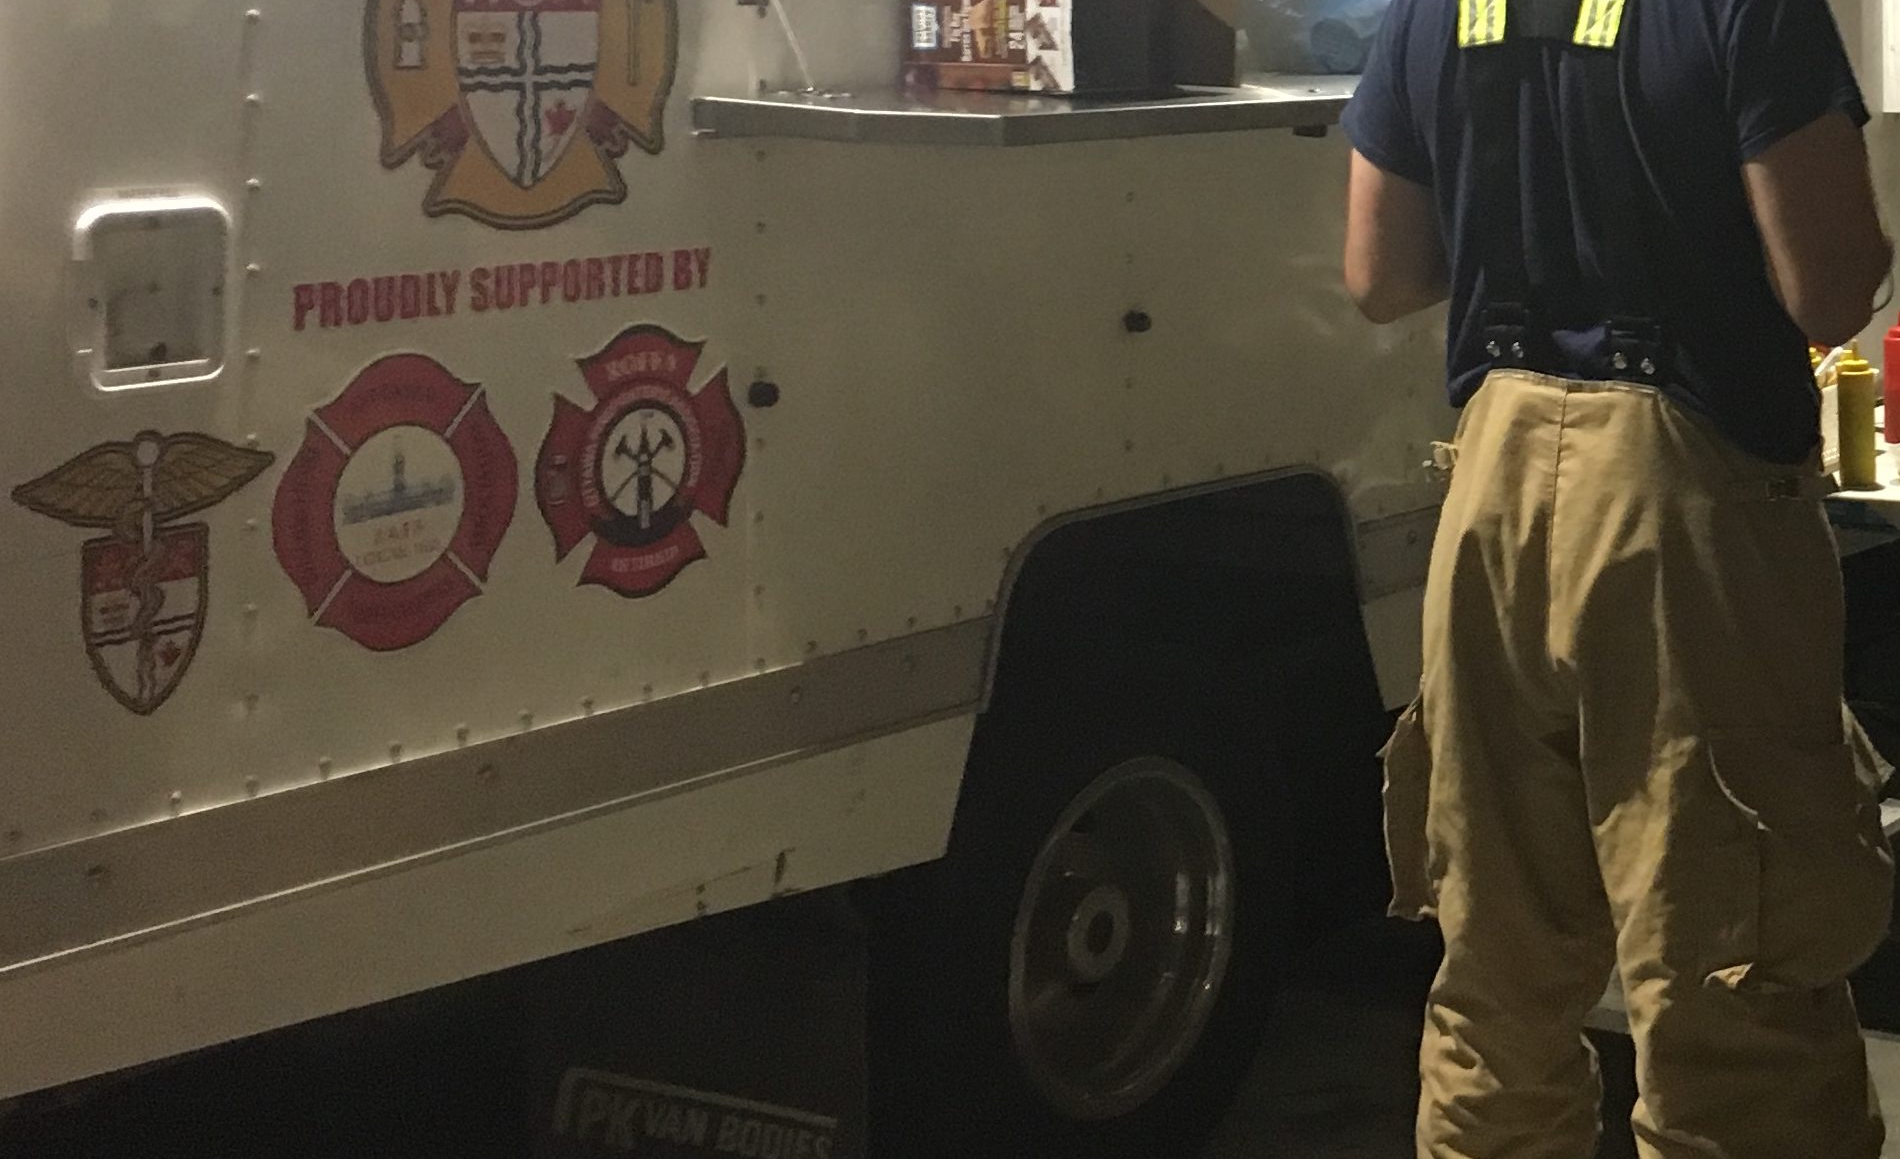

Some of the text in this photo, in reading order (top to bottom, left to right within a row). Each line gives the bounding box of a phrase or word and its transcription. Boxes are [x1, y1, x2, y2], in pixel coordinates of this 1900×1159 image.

[292, 246, 712, 331] PROUDLY SUPPORTED BY
[641, 1095, 709, 1146] VAN
